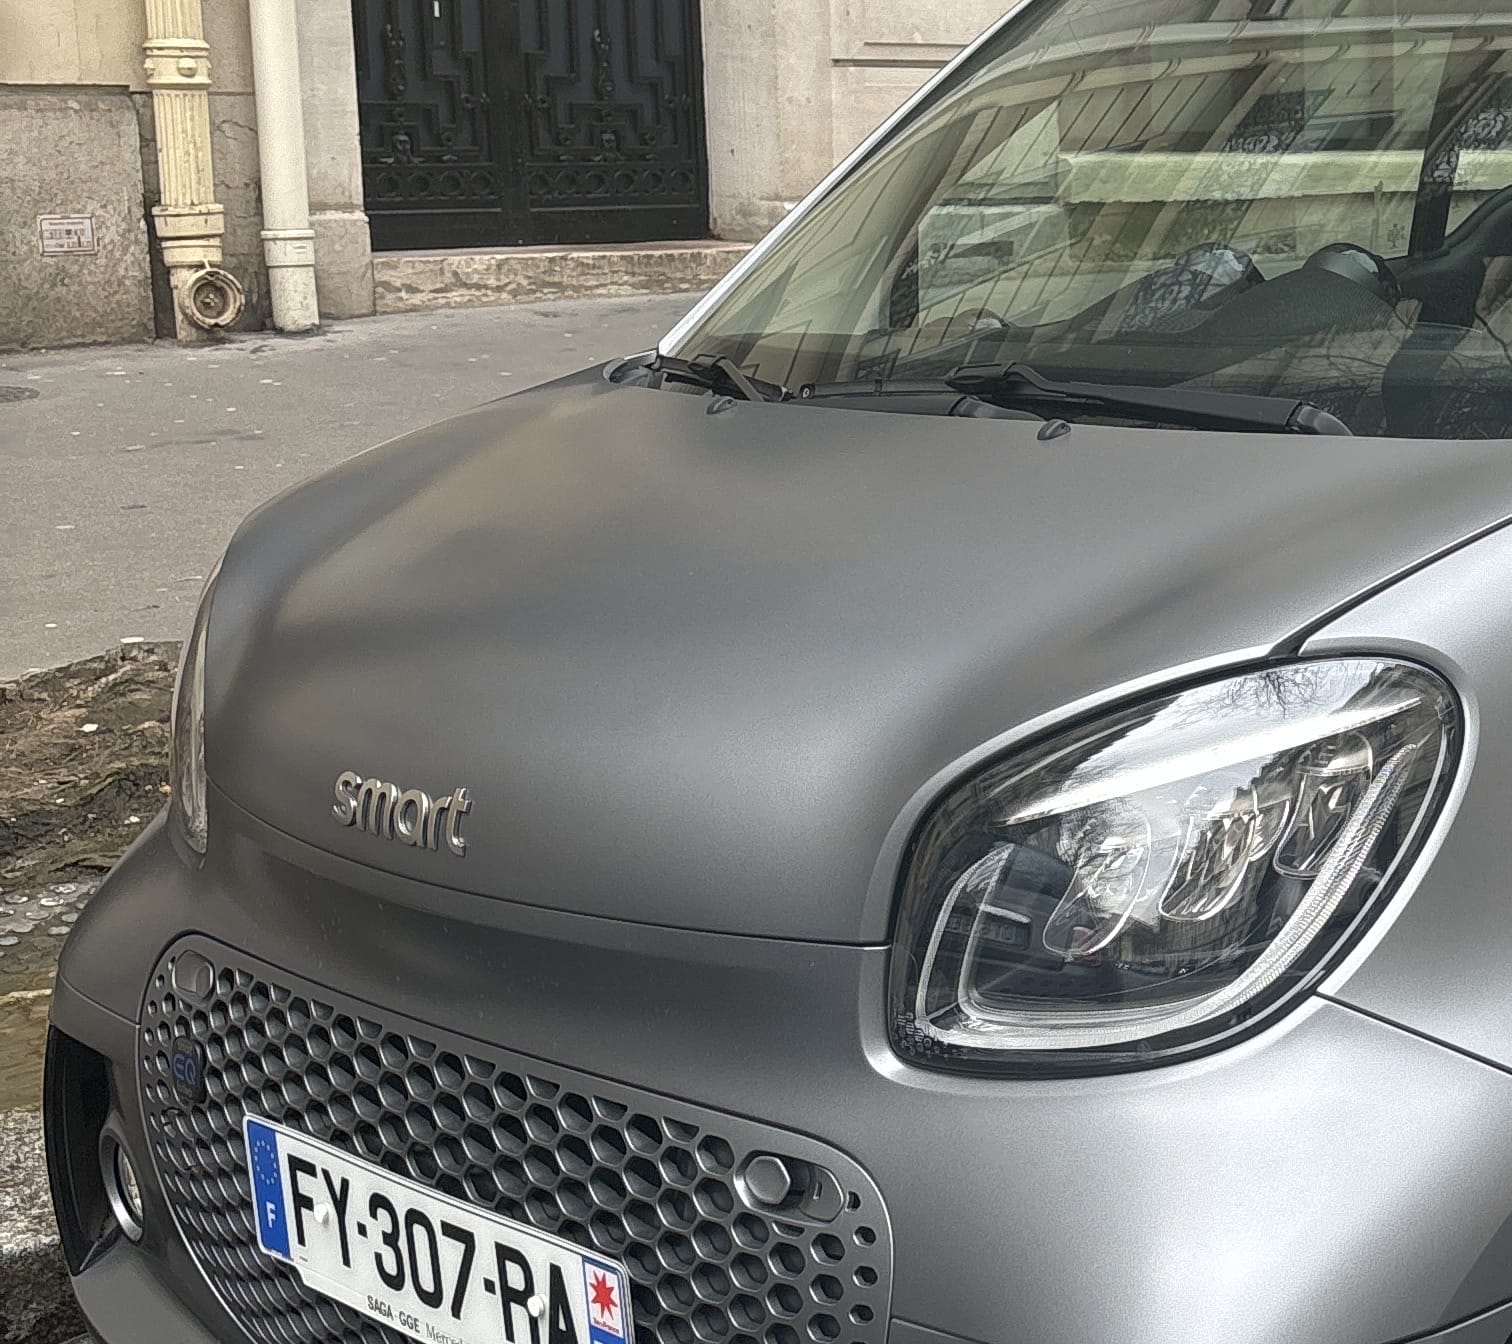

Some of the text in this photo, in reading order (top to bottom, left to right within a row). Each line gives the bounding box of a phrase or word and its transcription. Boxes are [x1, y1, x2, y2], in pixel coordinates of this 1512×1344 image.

[333, 770, 473, 859] smart
[173, 1053, 196, 1085] EQ
[265, 1202, 277, 1229] F
[367, 1294, 394, 1322] SAGA
[398, 1310, 421, 1334] GGE
